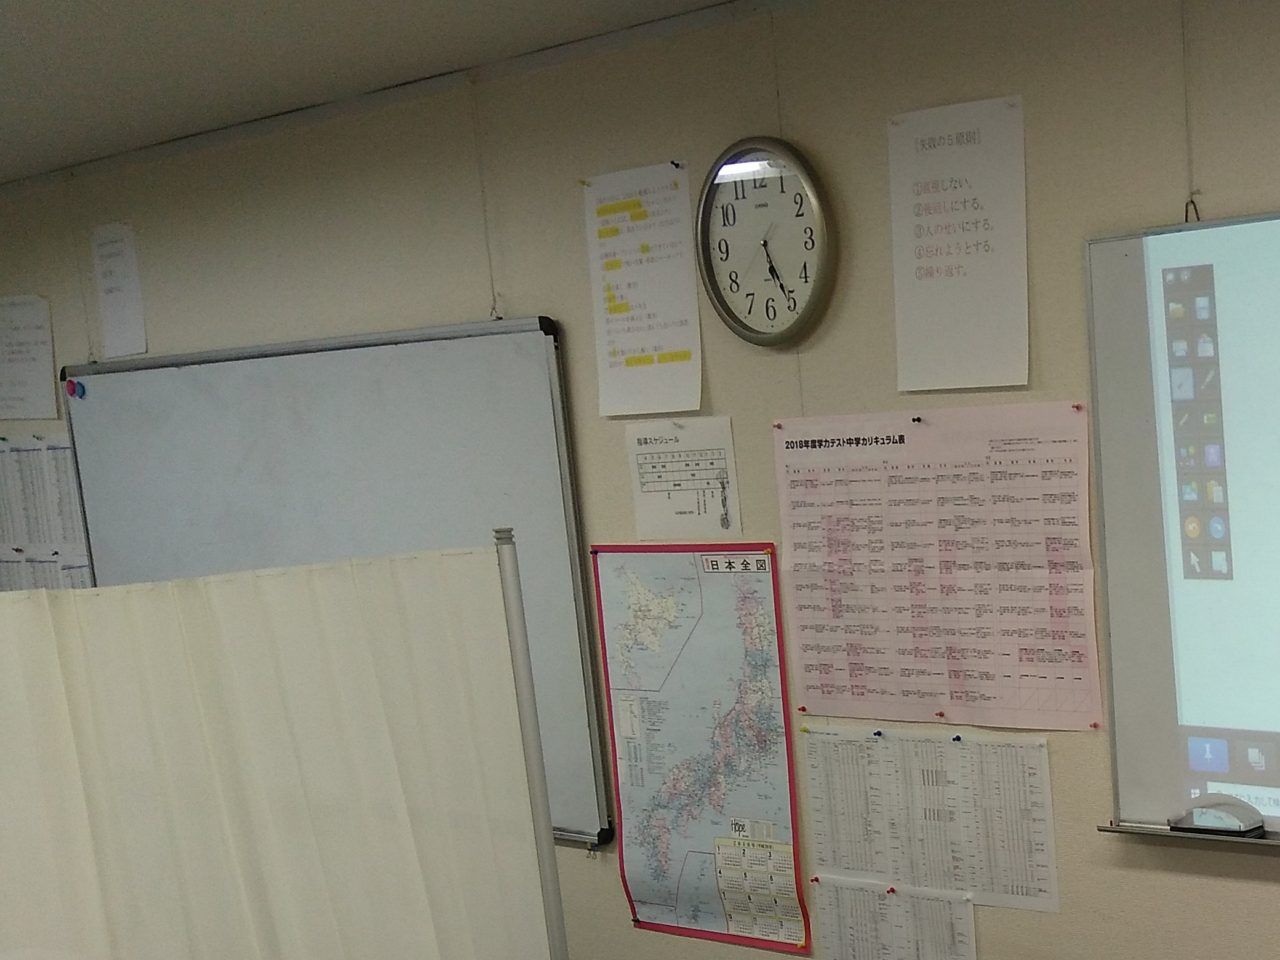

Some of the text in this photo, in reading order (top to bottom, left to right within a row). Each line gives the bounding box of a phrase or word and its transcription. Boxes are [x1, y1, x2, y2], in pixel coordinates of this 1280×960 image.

[733, 179, 747, 201] 11
[780, 173, 786, 194] 1
[720, 202, 737, 228] 10
[793, 192, 805, 218] 2
[718, 238, 730, 262] 9
[803, 226, 816, 251] 3
[728, 270, 740, 293] 8
[799, 261, 810, 284] 4
[745, 292, 756, 315] 7
[765, 297, 777, 321] 6
[787, 289, 798, 312] 5
[709, 558, 768, 571] 日本全図
